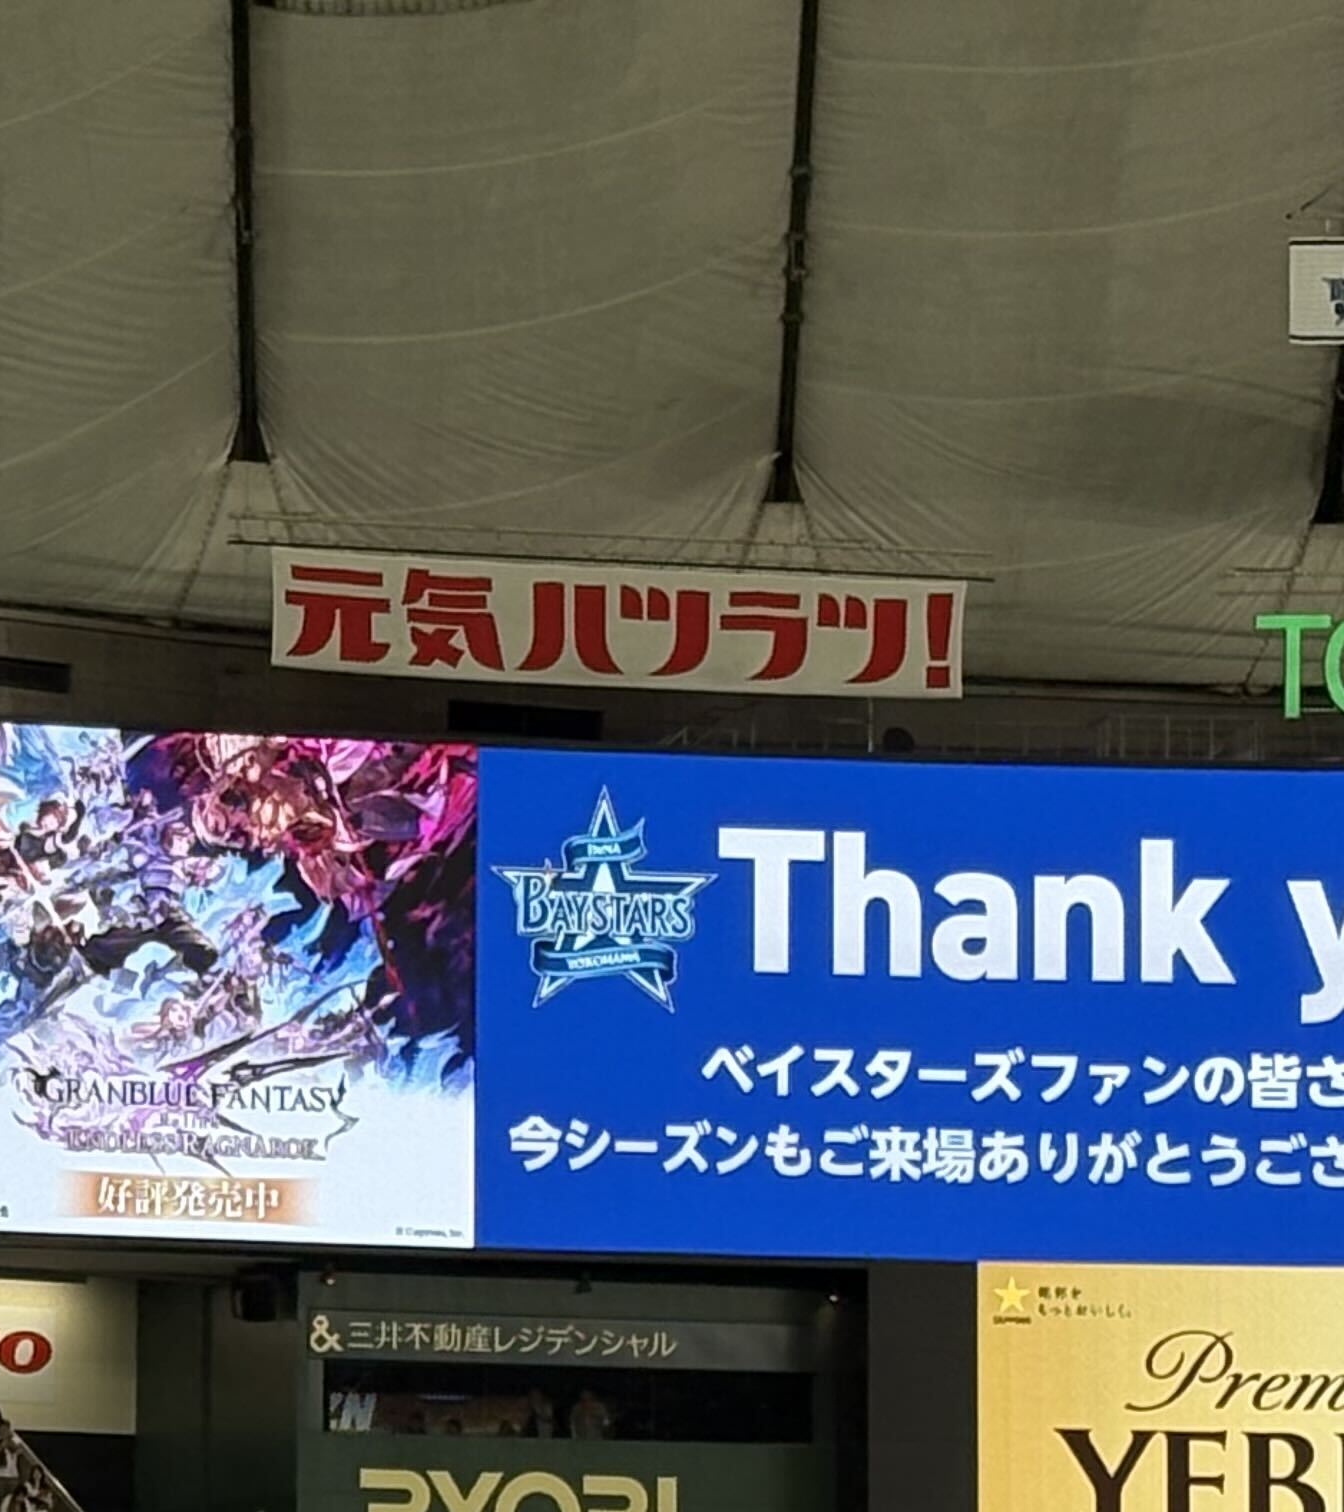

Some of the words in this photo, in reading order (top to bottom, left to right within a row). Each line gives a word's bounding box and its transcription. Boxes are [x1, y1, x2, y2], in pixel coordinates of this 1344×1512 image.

[284, 562, 955, 689] 元気ハツラツ!
[1255, 614, 1344, 719] T
[516, 873, 691, 936] BAYSTARS
[718, 826, 1237, 985] Thank
[39, 1074, 206, 1108] GRANBLUE
[210, 1072, 348, 1114] FANTASY
[97, 1177, 281, 1220] 好評発売中
[347, 1321, 678, 1360] 三井不動産レジデンシャル
